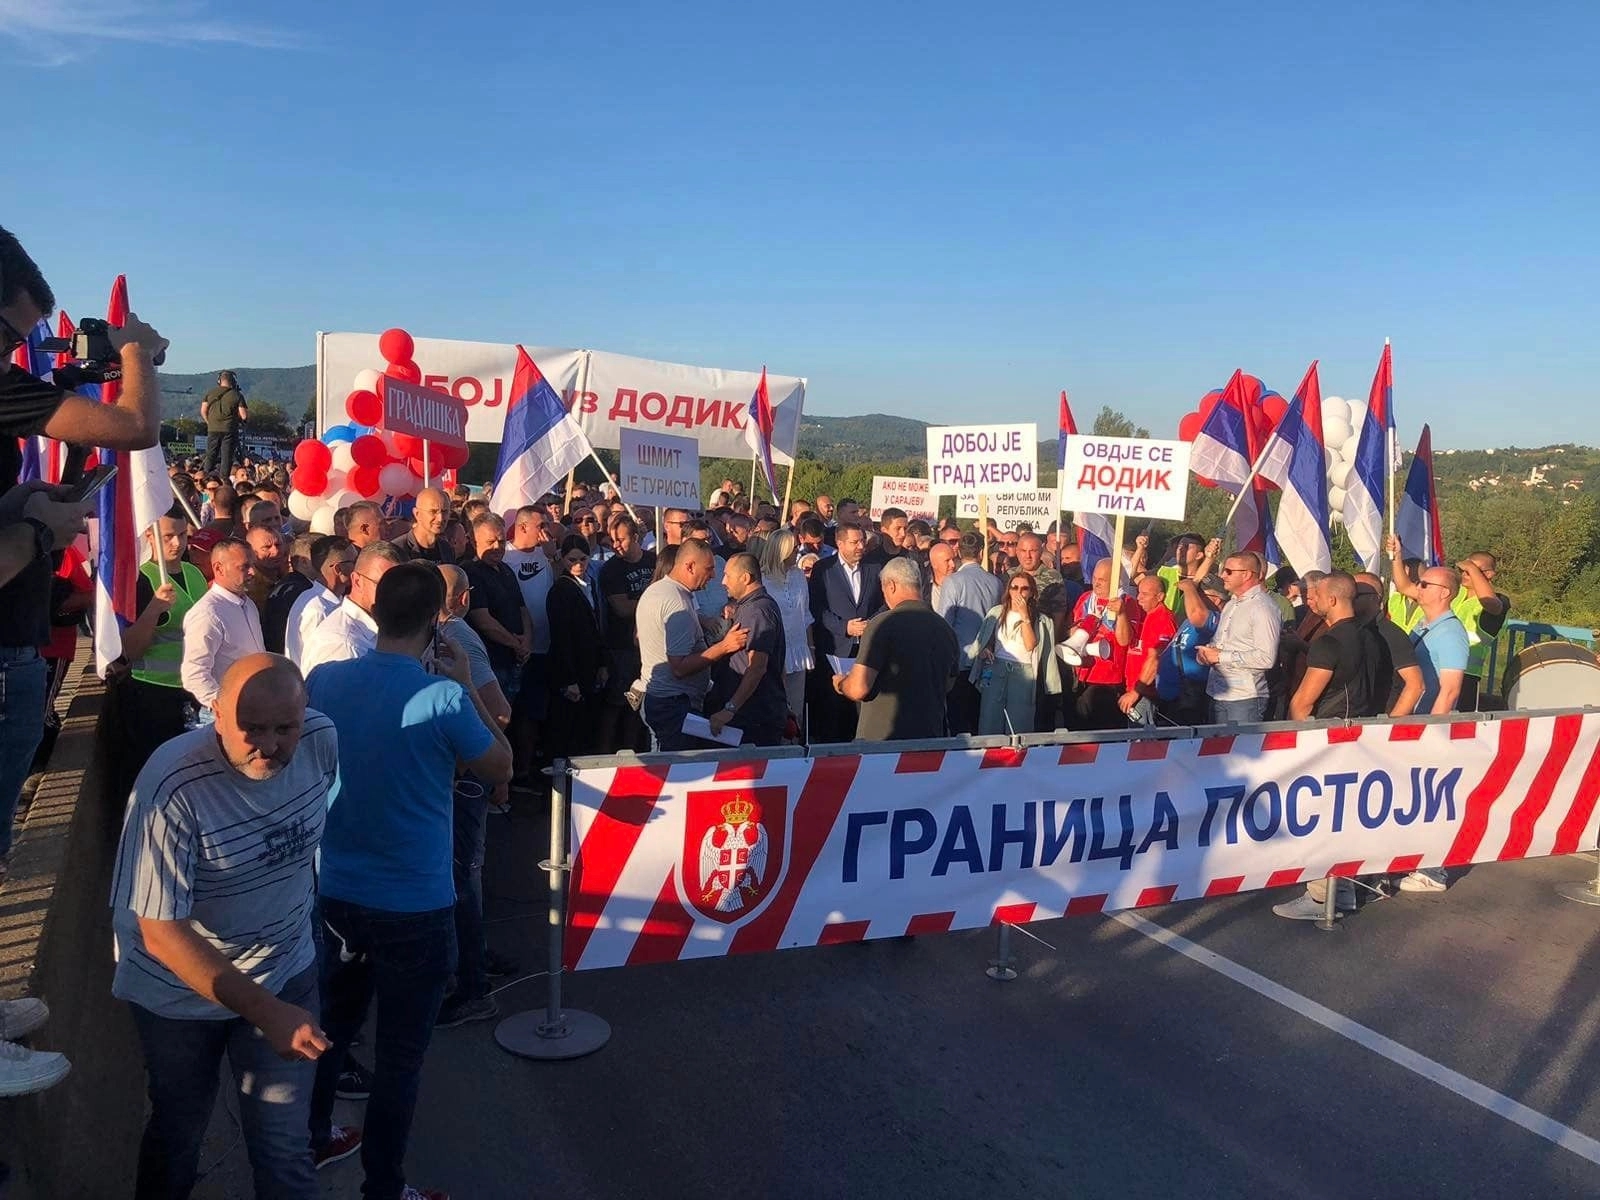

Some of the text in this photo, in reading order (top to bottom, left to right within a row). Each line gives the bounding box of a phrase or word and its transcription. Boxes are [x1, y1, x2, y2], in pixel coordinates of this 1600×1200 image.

[425, 375, 503, 407] БОЈ
[388, 387, 461, 438] ГРАДИШКА
[638, 444, 682, 468] ШМИТ
[942, 431, 1022, 459] ДОБОЈ ЈЕ
[1083, 443, 1173, 463] ОВДЈЕ СЕ
[624, 475, 698, 499] ЈЕ ТУРИСТА
[882, 481, 929, 493] АКО НЕ МОЖЕ
[934, 463, 1032, 488] ГРАД ХЕРОЈ
[1077, 464, 1172, 493] ДОДИК
[891, 495, 924, 506] САРАЈЕВУ
[1038, 492, 1051, 502] МИ
[1098, 494, 1145, 512] ПИТА
[997, 505, 1050, 516] РЕПУБЛИКА
[520, 561, 539, 572] NIKE
[841, 766, 1464, 884] ГРАНИЦА ПОСТОЈИ
